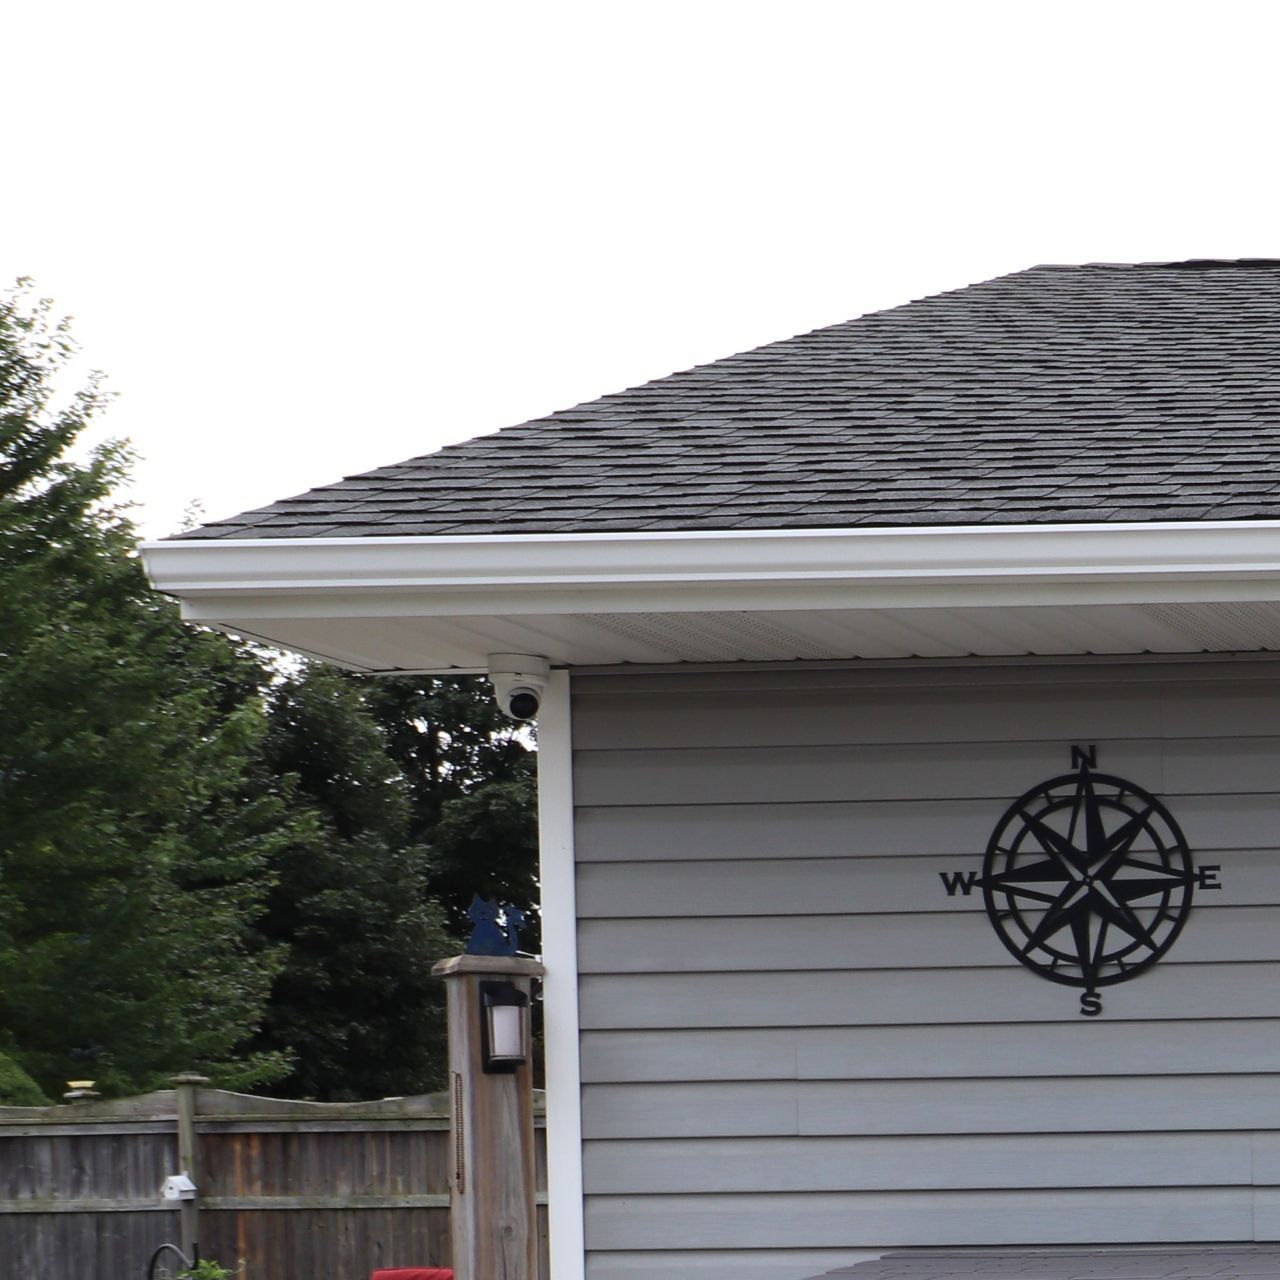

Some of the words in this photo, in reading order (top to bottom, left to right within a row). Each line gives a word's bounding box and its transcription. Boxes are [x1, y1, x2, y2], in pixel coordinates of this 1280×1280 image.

[1070, 744, 1097, 769] N
[939, 871, 977, 896] W
[1198, 864, 1222, 890] E
[1080, 992, 1103, 1016] S
